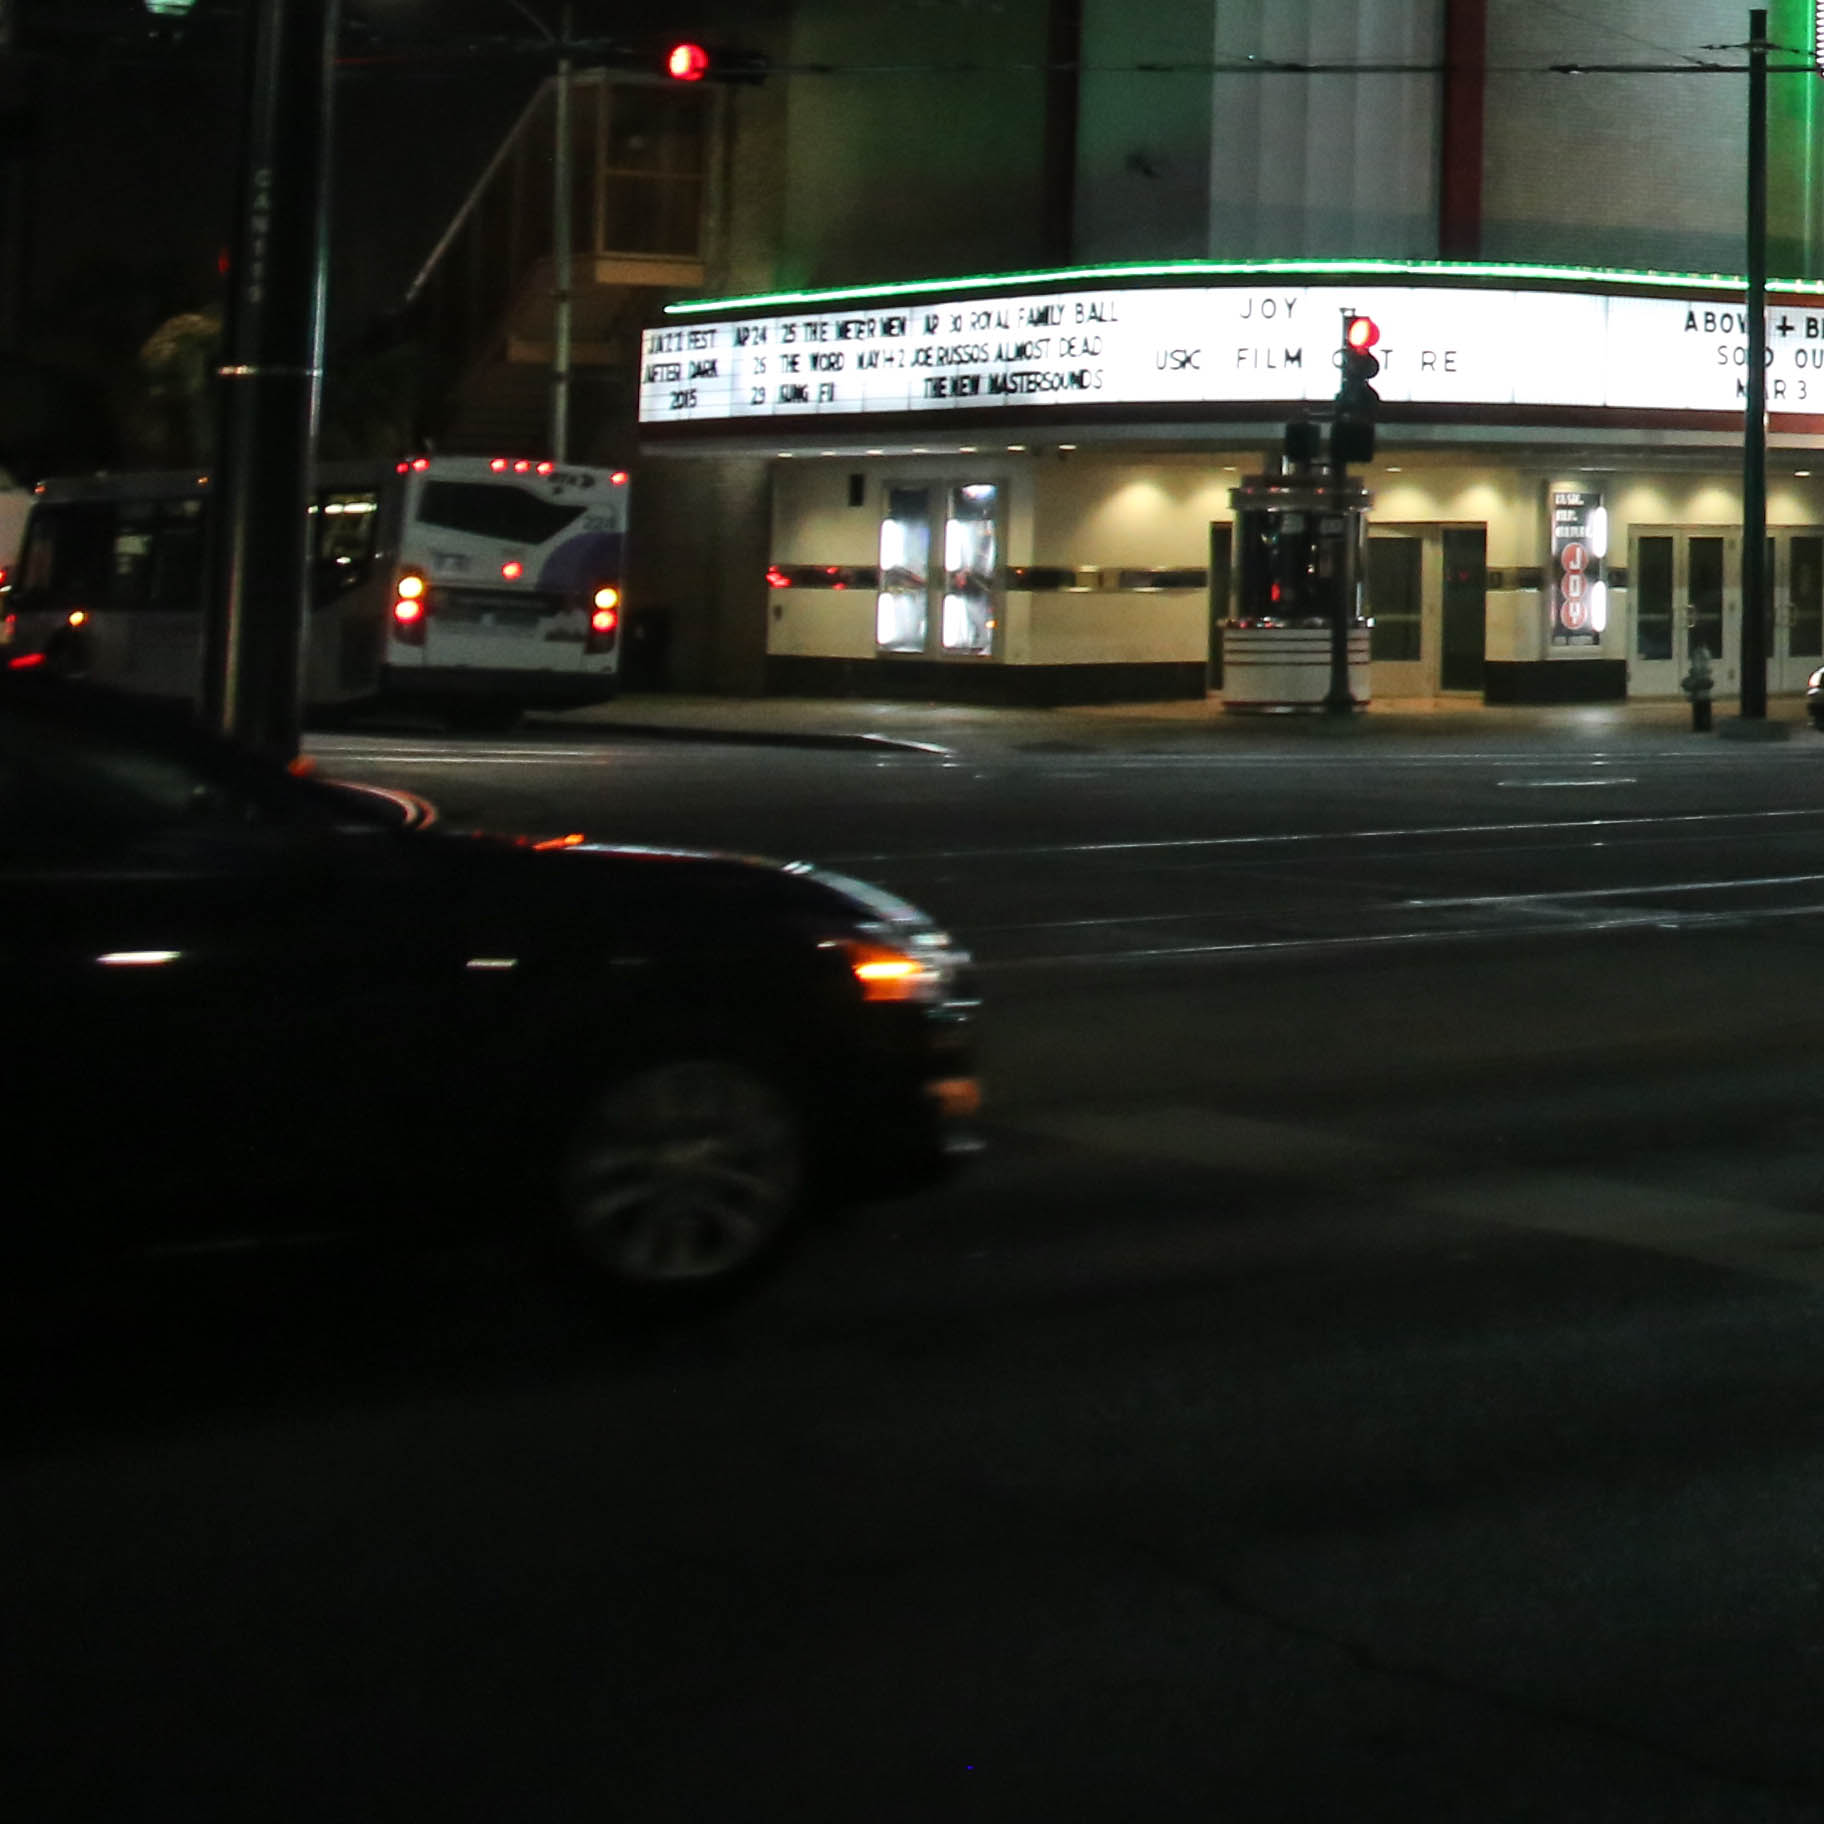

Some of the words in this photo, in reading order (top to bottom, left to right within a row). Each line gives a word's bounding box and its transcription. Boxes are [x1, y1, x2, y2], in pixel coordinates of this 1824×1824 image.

[970, 308, 1011, 332] ROYAL
[1018, 303, 1066, 329] FAMILY
[1074, 299, 1119, 324] BALL
[1240, 297, 1298, 319] JOY
[802, 321, 829, 343] THE
[1684, 310, 1750, 334] ABOV
[688, 329, 717, 351] FEST
[910, 346, 934, 368] JOE
[935, 342, 990, 368] RUSSOS
[993, 337, 1051, 364] ALMOST
[1058, 335, 1104, 359] DEAD
[780, 353, 801, 374] THE
[809, 351, 846, 373] WORD
[1236, 347, 1303, 370] FILM
[1716, 344, 1775, 368] SOD
[642, 362, 682, 385] AFTER
[688, 359, 718, 380] DARK
[923, 376, 947, 399] THE
[987, 367, 1104, 396] MASTERSOUNDS
[669, 388, 698, 411] 2015
[1797, 379, 1809, 400] 3
[1565, 545, 1584, 627] JOY
